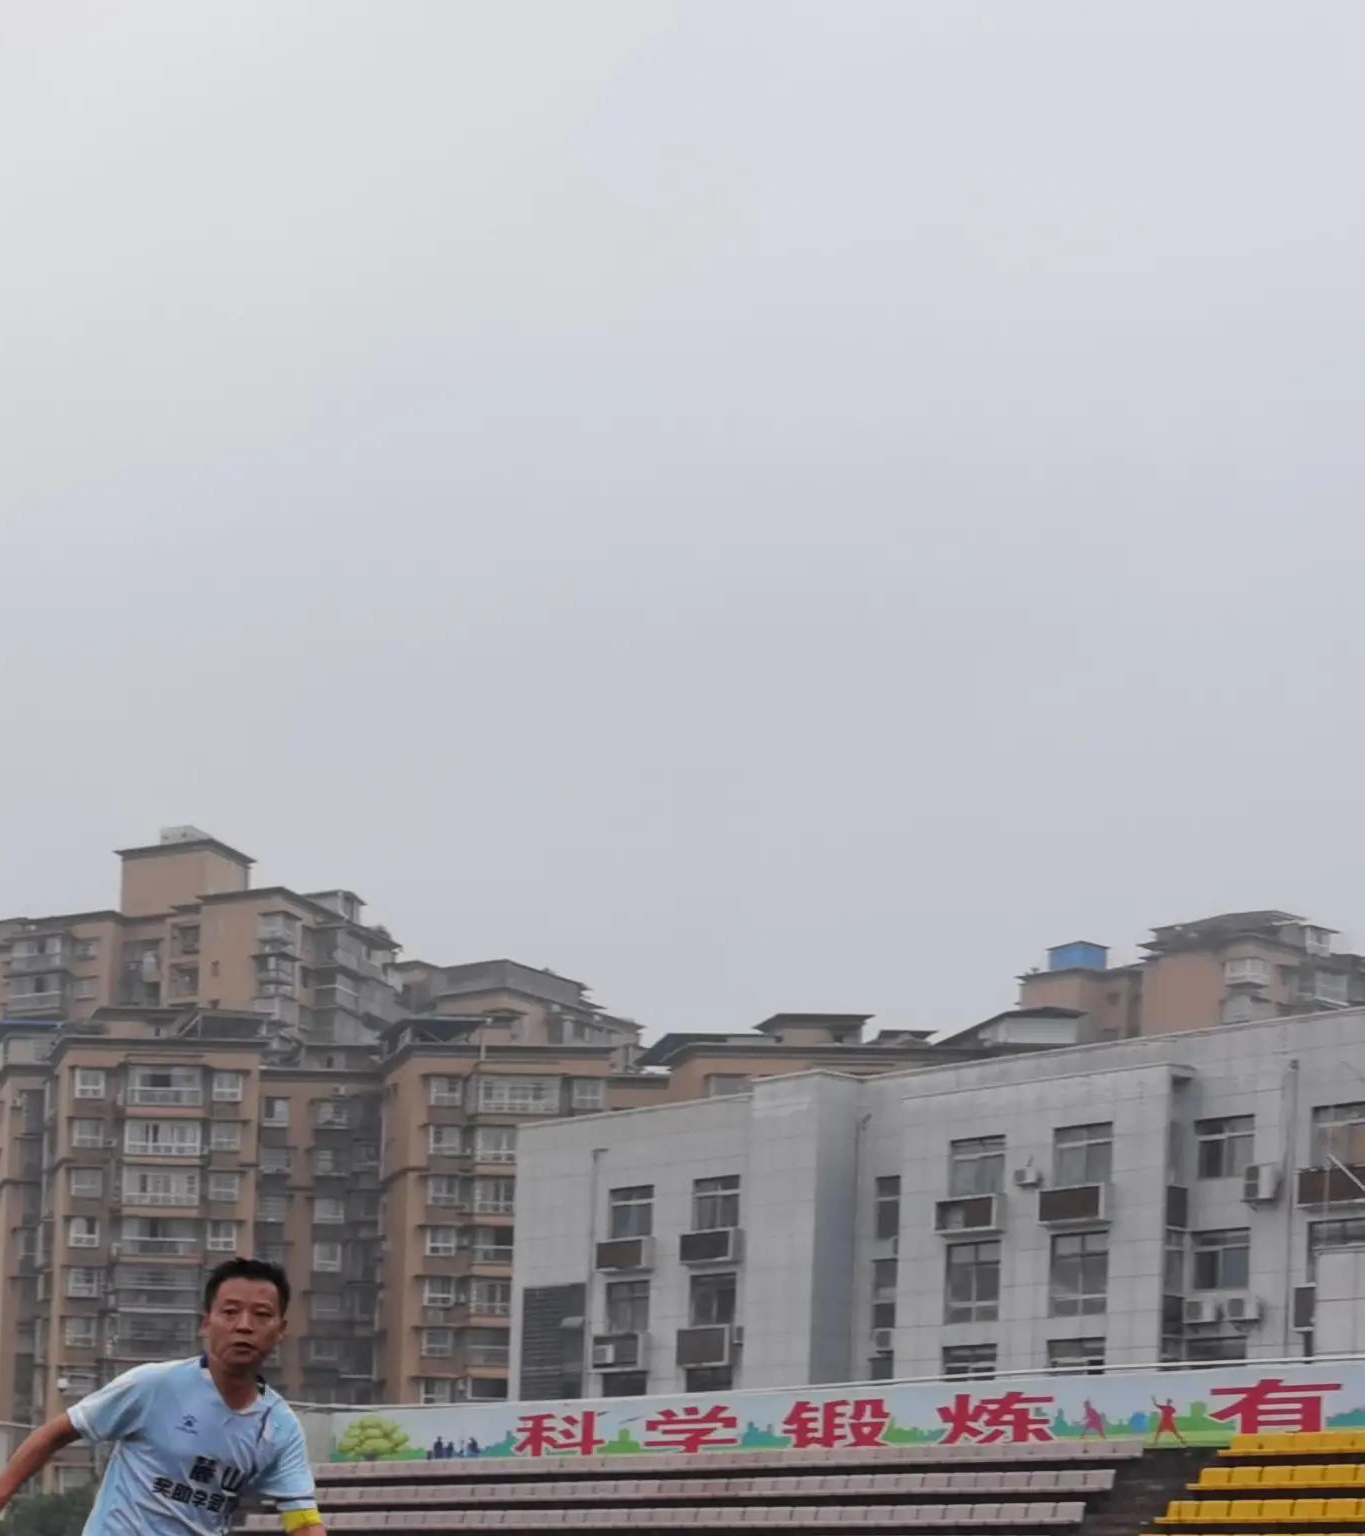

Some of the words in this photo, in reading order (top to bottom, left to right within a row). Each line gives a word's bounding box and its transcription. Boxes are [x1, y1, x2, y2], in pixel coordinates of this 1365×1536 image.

[515, 1391, 1056, 1456] 科学锻炼
[1209, 1379, 1342, 1435] 有
